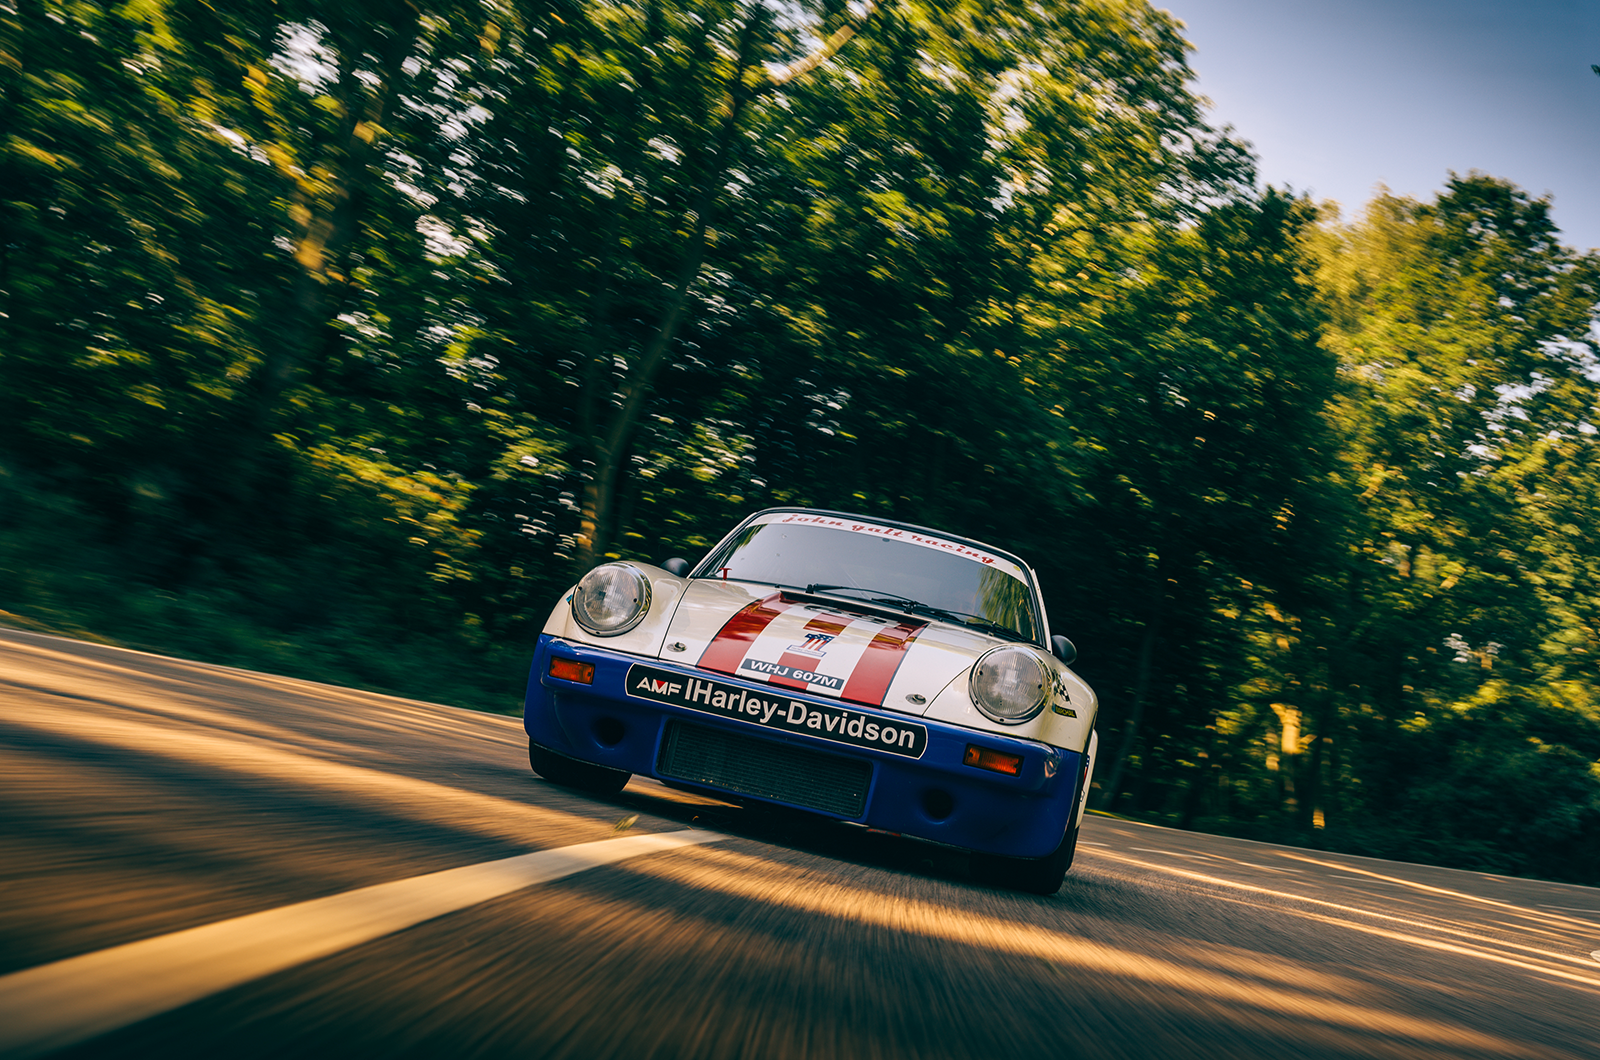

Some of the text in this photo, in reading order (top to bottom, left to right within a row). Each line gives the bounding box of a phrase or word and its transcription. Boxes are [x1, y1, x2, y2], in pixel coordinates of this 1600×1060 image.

[781, 514, 996, 564] john galt racing
[636, 676, 682, 696] AMF
[750, 660, 838, 688] WHJ 607M
